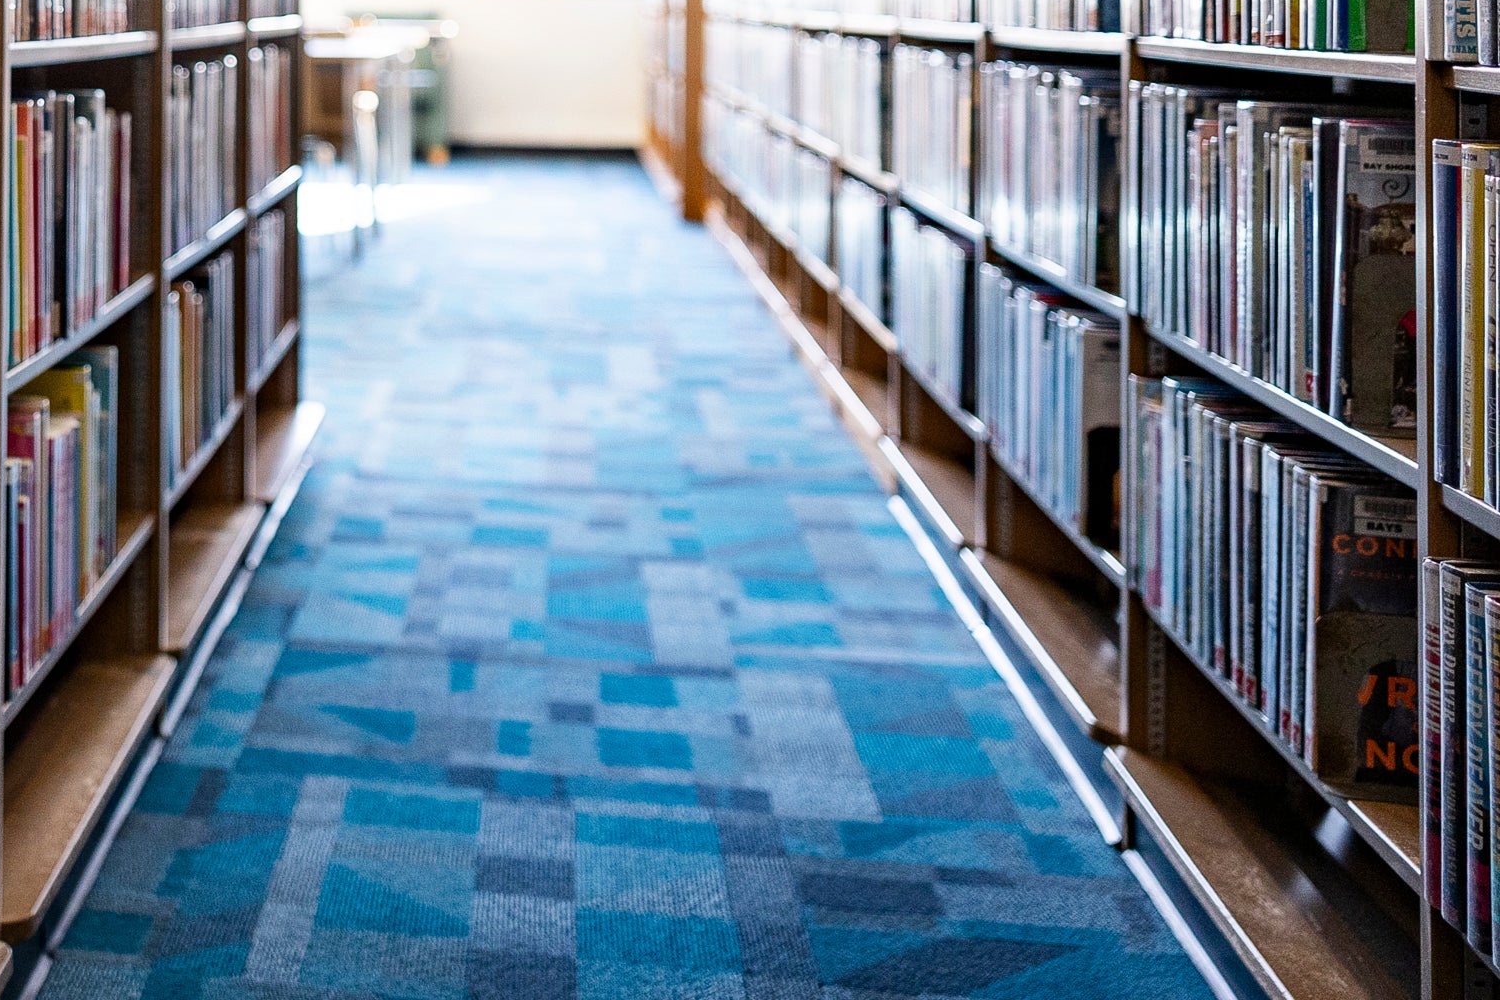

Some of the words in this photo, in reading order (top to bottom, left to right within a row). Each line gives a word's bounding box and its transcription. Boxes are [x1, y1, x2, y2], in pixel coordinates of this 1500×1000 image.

[1464, 399, 1473, 446] DALTON
[1444, 654, 1457, 723] DEAVER
[1467, 624, 1484, 738] JEFFERY
[1468, 741, 1485, 851] DEAVER
